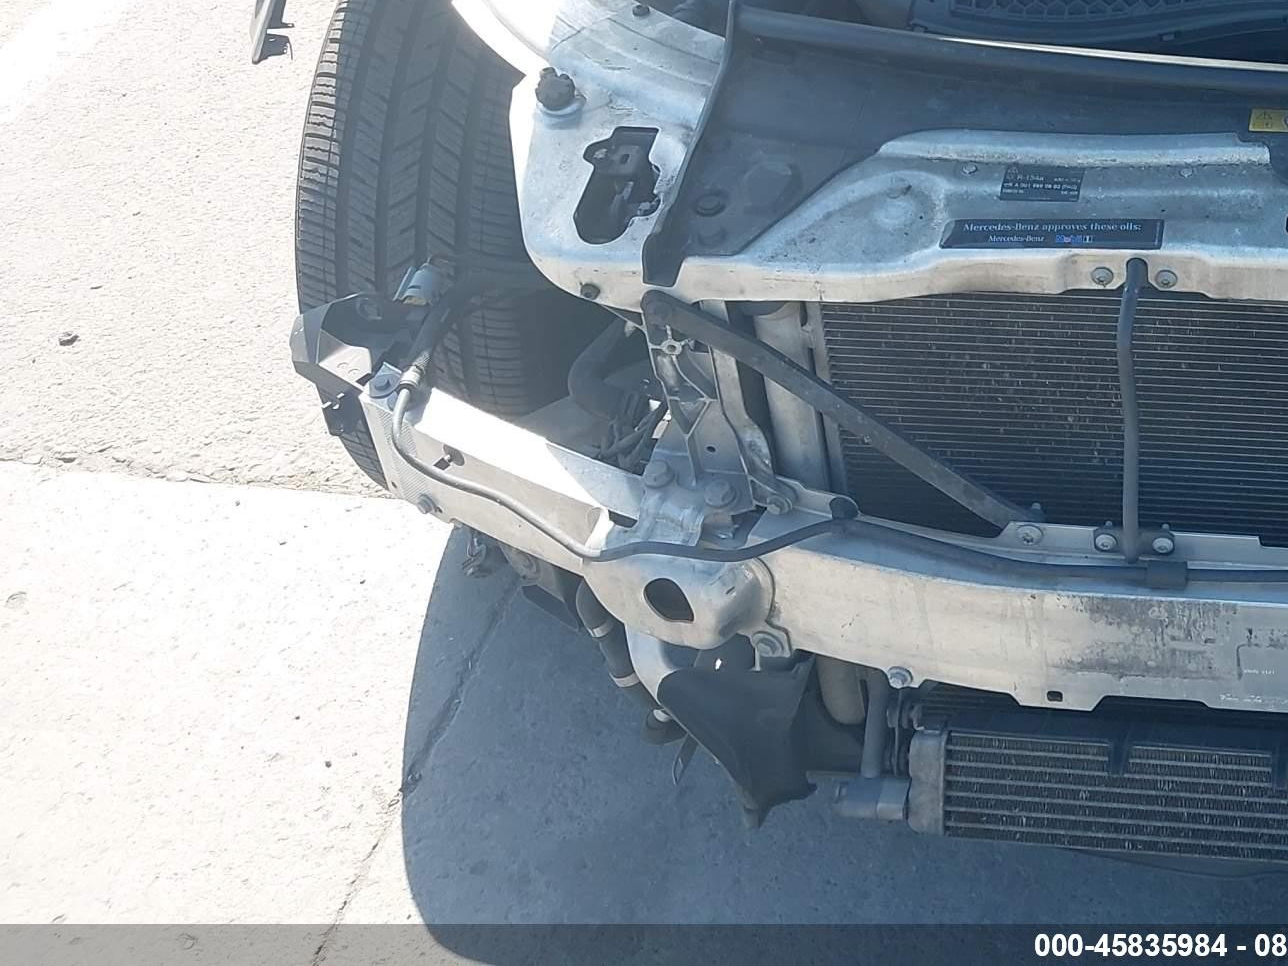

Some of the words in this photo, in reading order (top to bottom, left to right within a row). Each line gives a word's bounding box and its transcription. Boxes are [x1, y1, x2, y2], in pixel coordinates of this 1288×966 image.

[963, 222, 1040, 232] Mercedes-Benz
[1041, 223, 1088, 233] approves
[1090, 222, 1117, 232] these
[988, 234, 1045, 243] Mercedes-Benz
